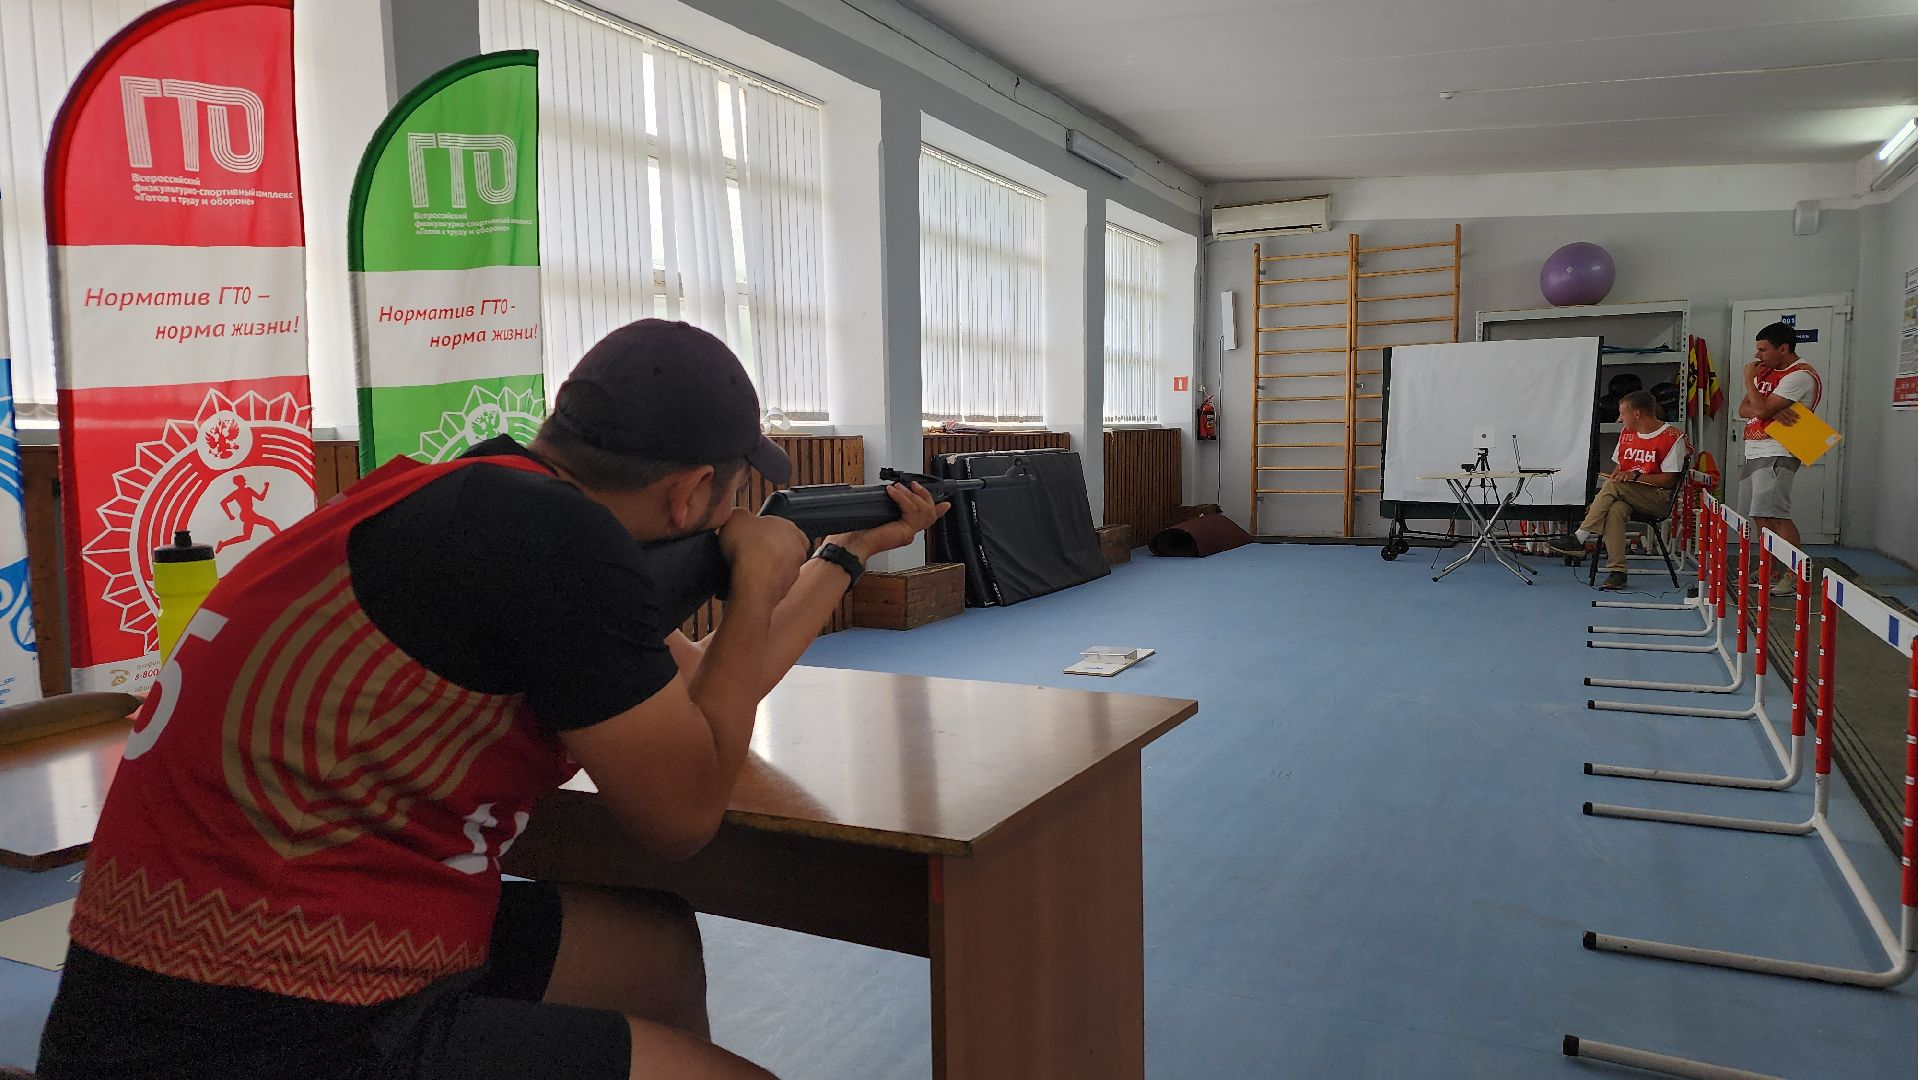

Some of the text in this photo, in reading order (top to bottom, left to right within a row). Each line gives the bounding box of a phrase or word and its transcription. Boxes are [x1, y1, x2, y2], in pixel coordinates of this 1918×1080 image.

[120, 75, 265, 173] ГТО
[407, 132, 518, 209] ГТО
[83, 287, 210, 311] Норматив
[218, 286, 252, 304] ГТО
[379, 305, 475, 325] Норматив
[480, 298, 508, 316] ГТО
[155, 315, 300, 343] норма жизни!
[429, 323, 538, 350] норма жизни!
